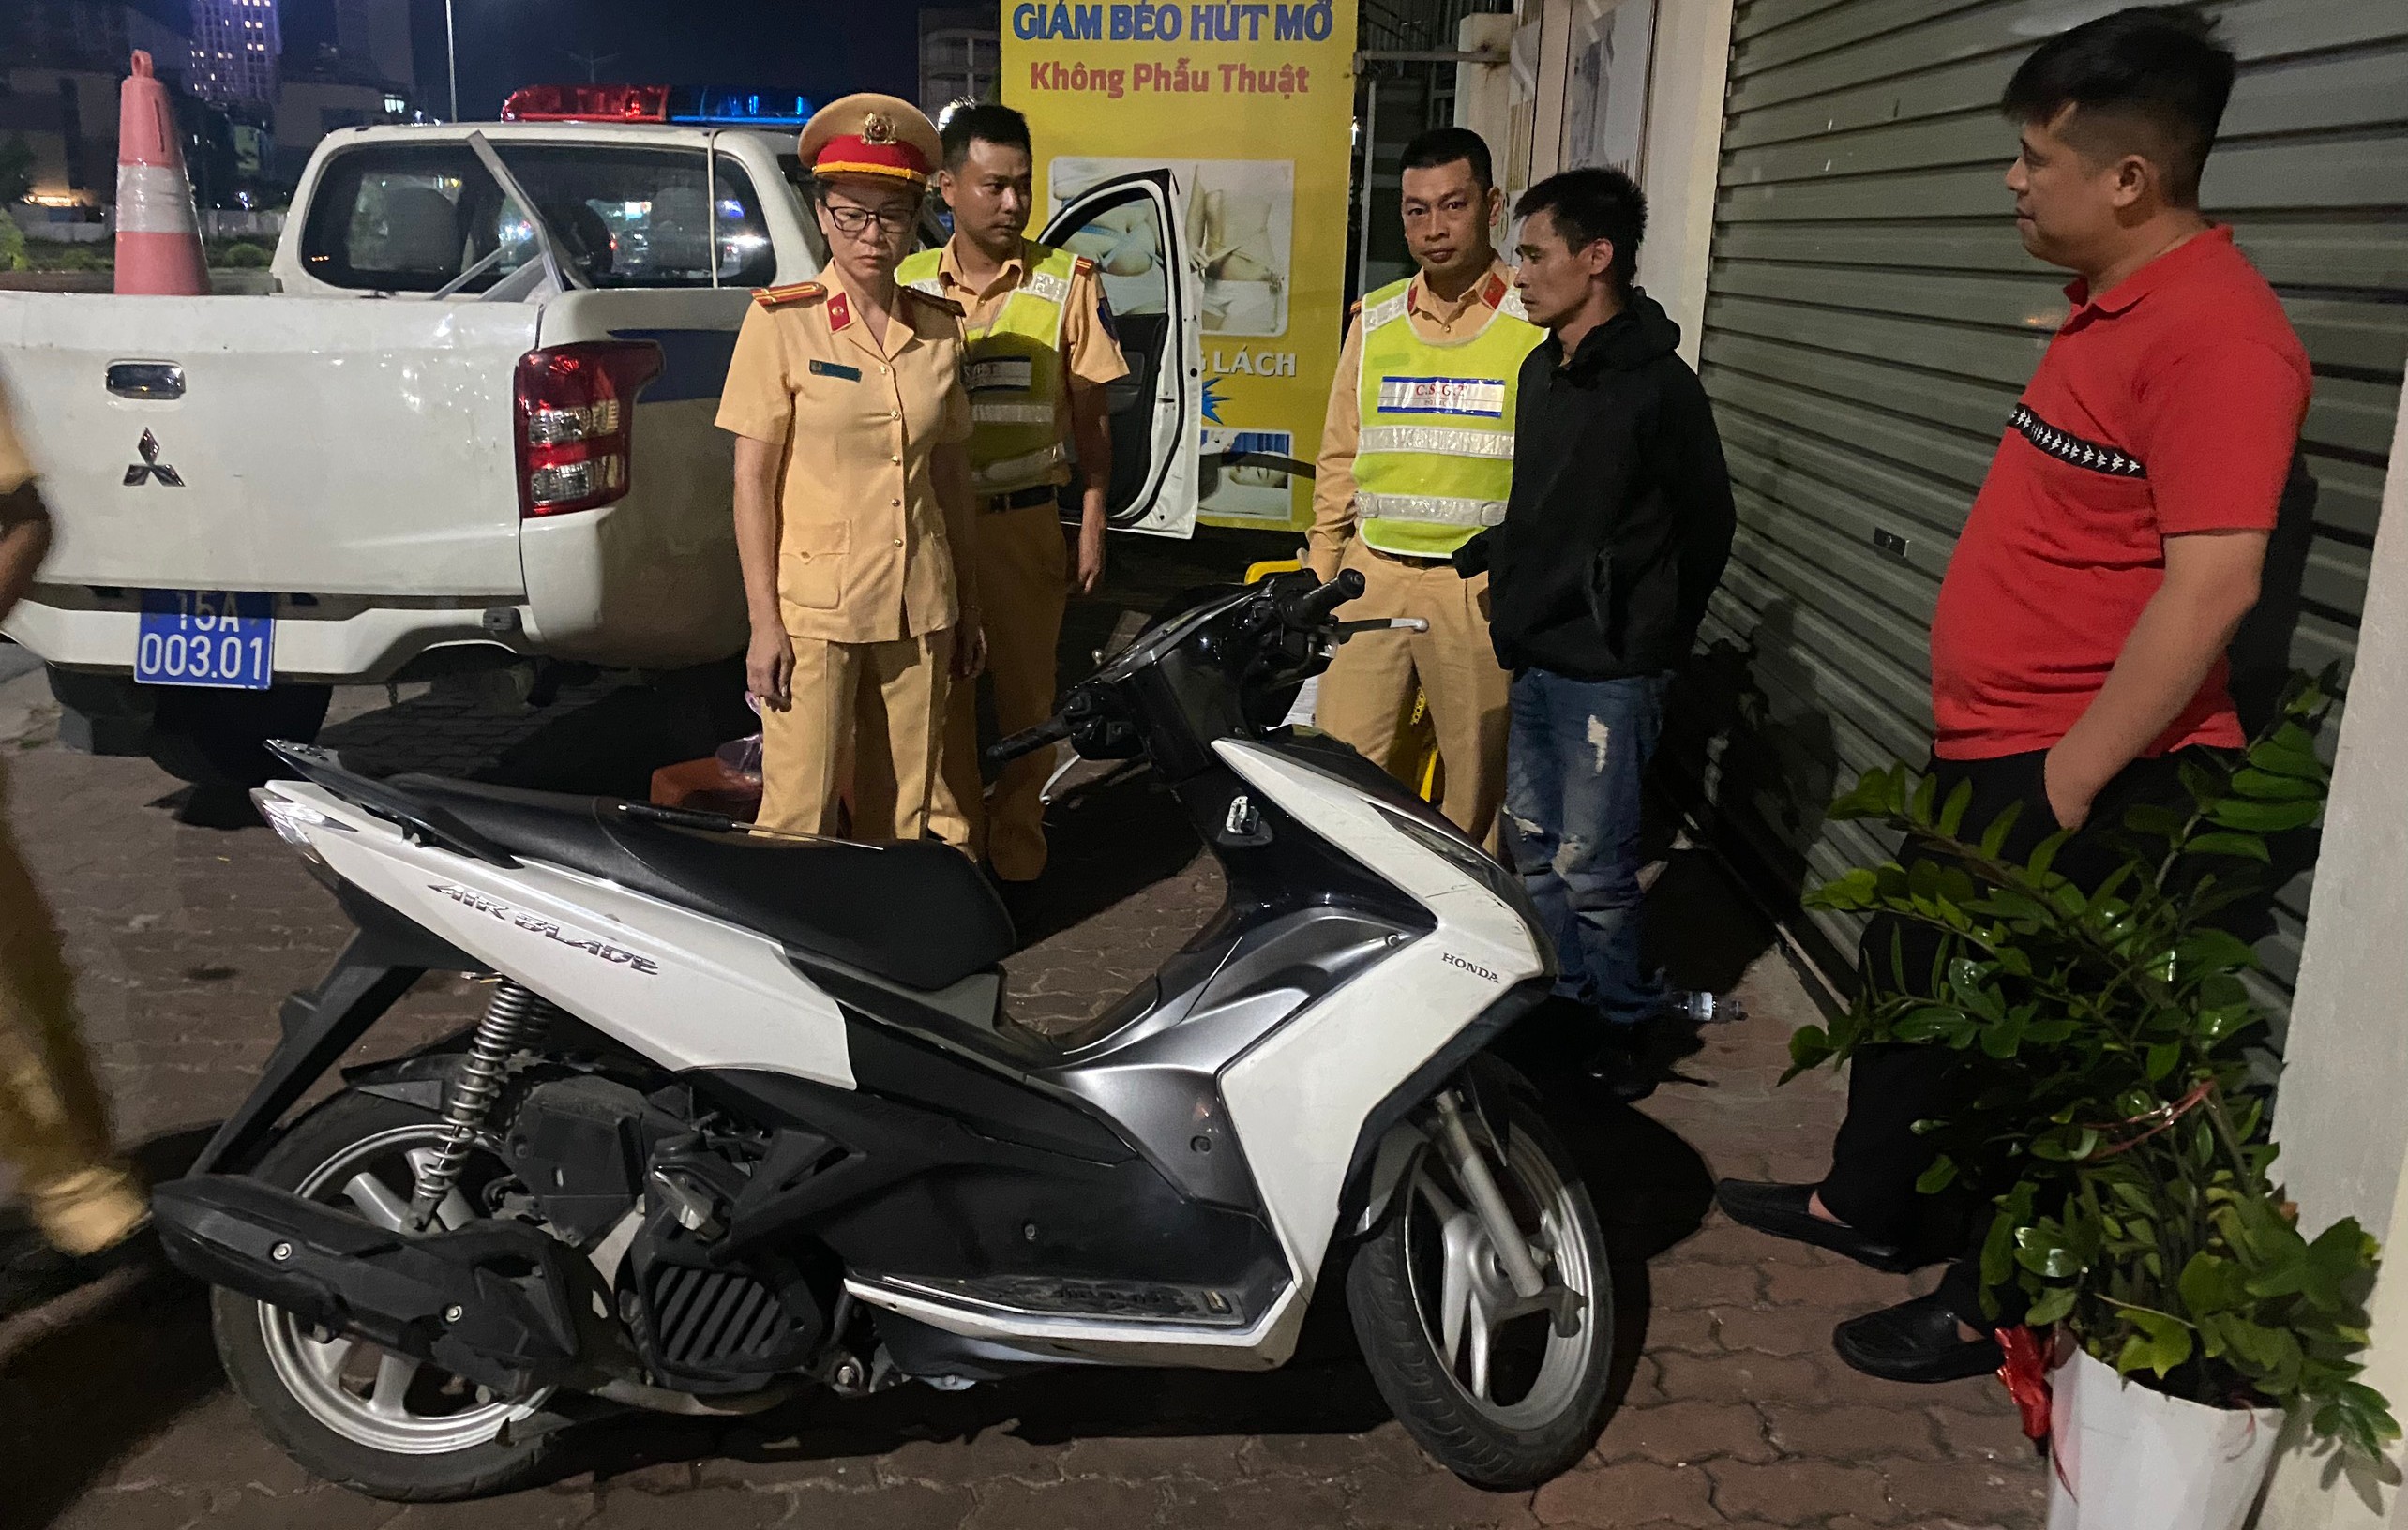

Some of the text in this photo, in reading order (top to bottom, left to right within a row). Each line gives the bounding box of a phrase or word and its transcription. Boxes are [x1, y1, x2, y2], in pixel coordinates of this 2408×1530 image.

[1109, 0, 1182, 41] BÉO
[1190, 0, 1269, 41] HÚT
[1031, 57, 1310, 100] Không Phẫu Thuật
[1213, 344, 1297, 377] LÁCH
[176, 590, 240, 633] 15A
[140, 633, 263, 681] 003.01
[427, 884, 658, 976] AIR BLADE
[1441, 952, 1499, 984] HONDA
